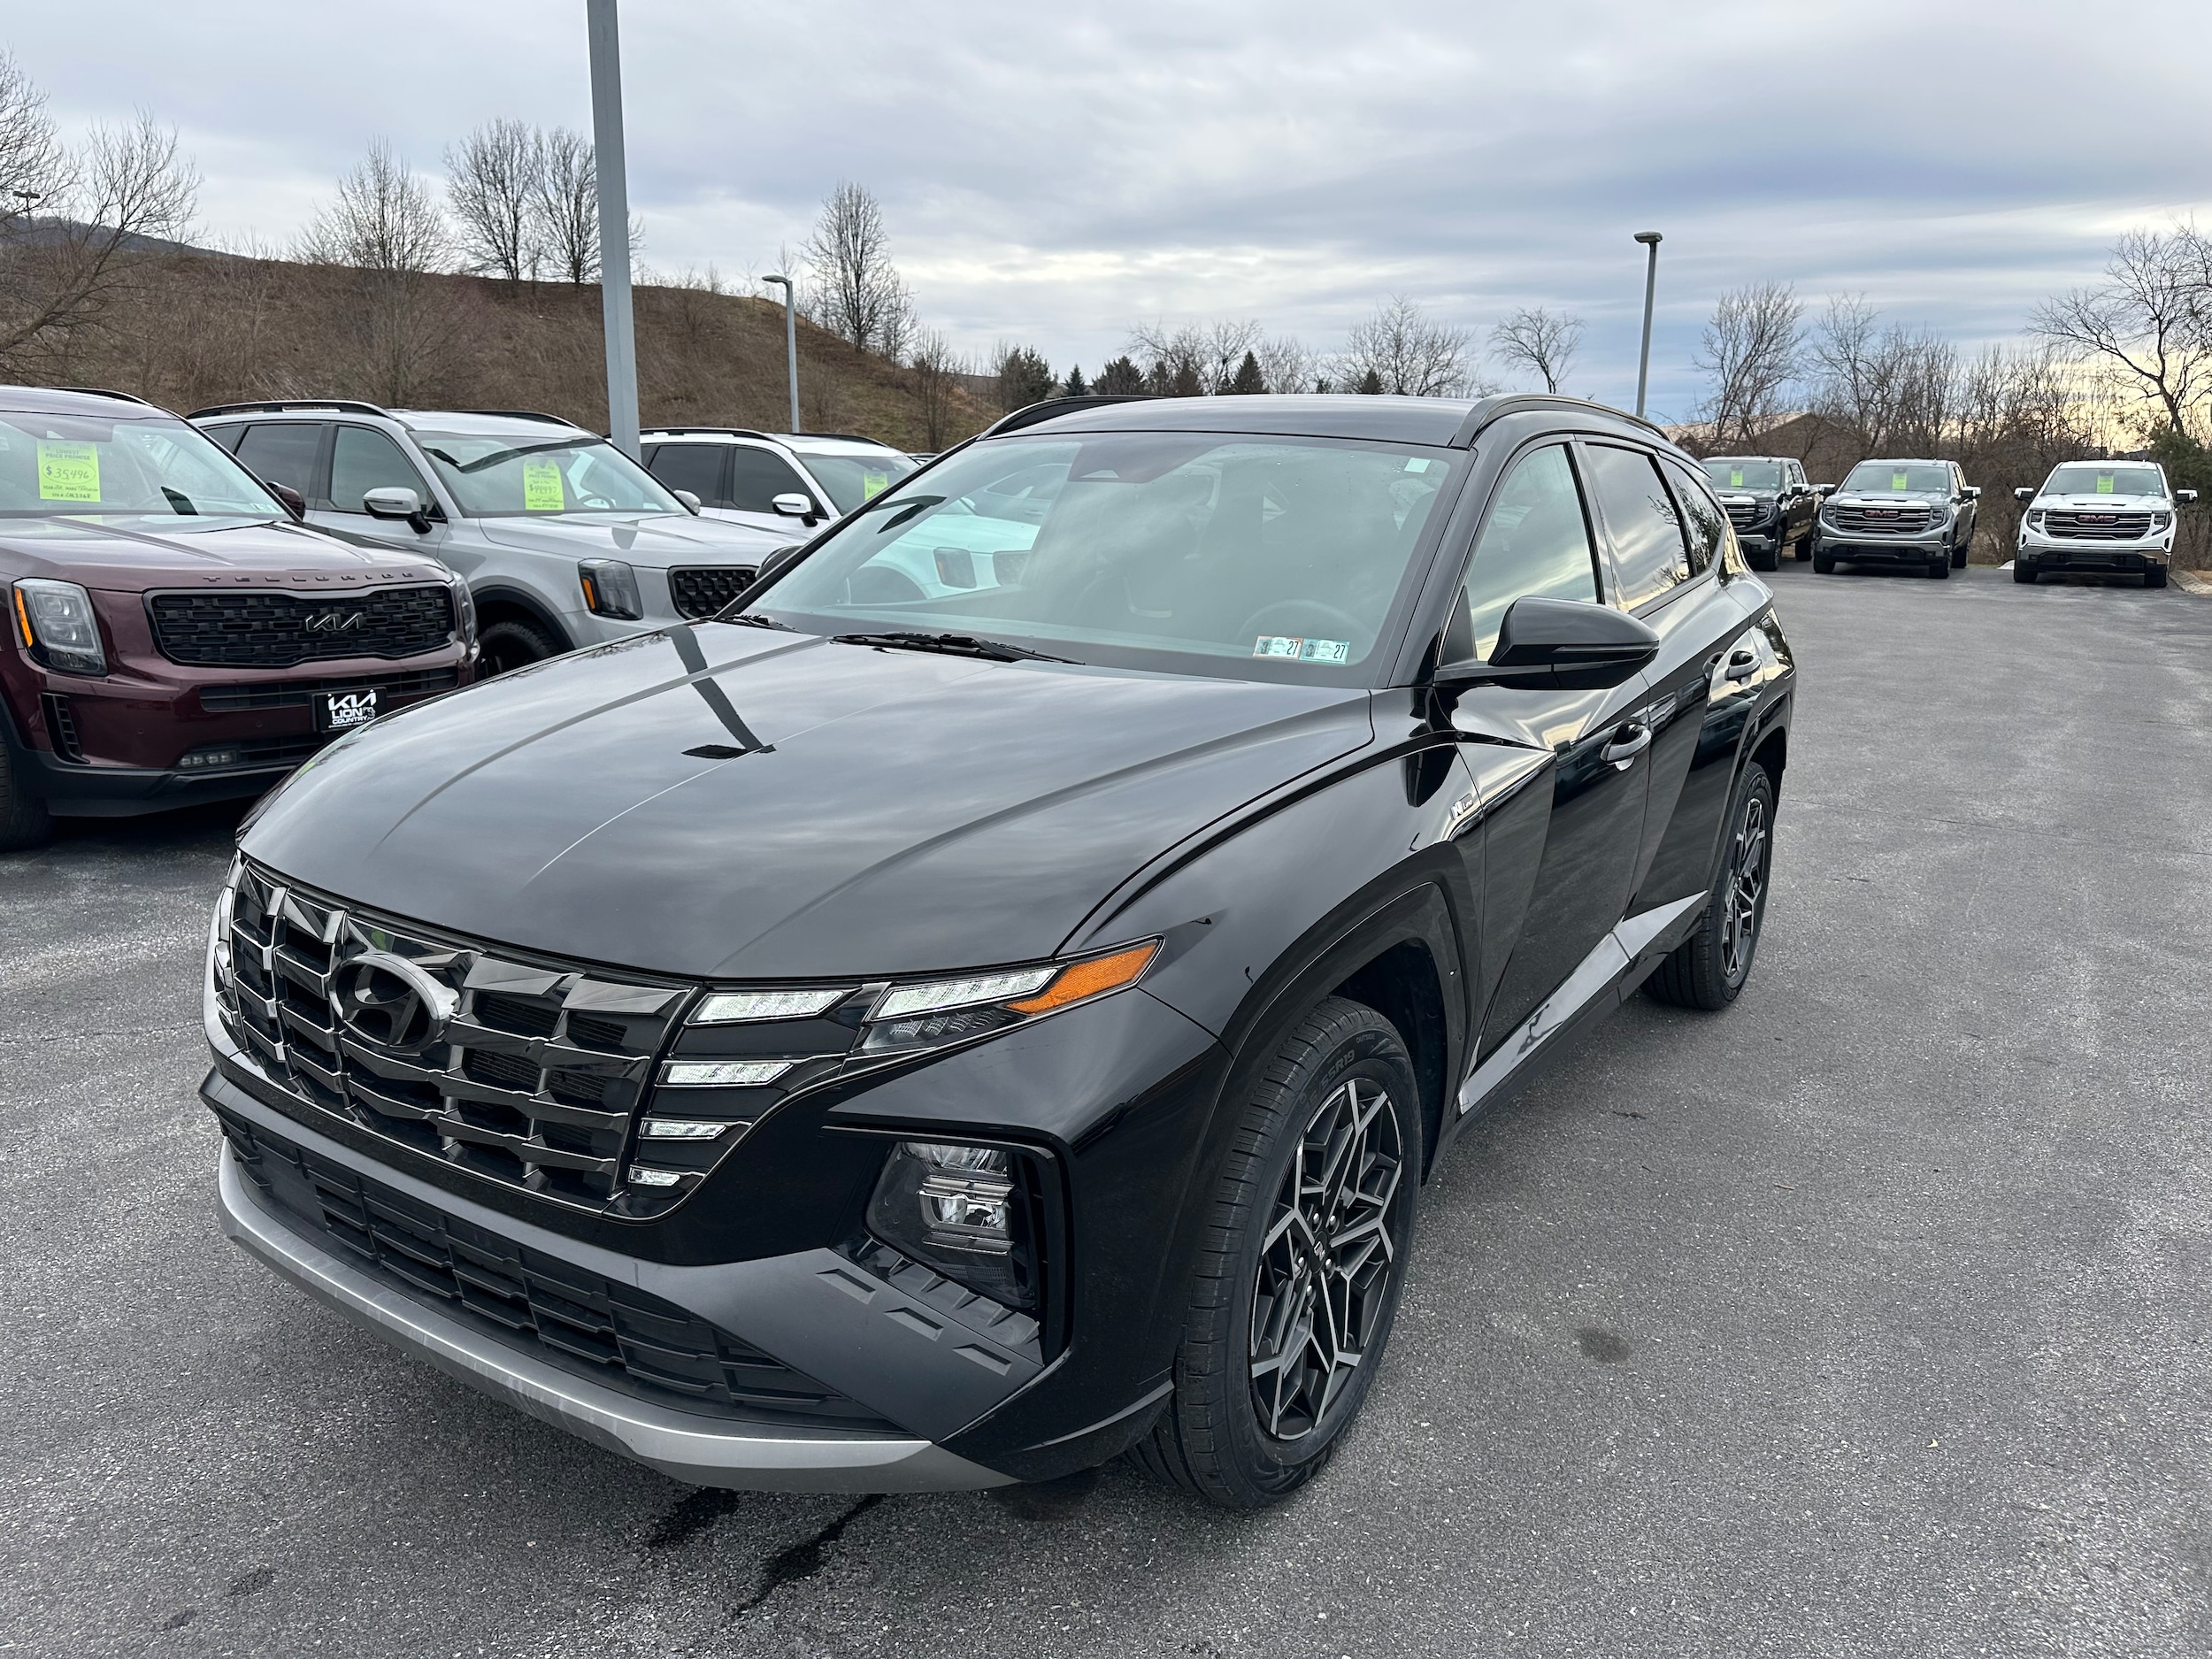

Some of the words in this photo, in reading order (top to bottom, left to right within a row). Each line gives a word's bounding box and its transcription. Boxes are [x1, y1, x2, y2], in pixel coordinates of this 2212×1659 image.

[1864, 509, 1899, 518] GMC
[203, 572, 413, 582] TELLURIDE
[1260, 641, 1269, 654] 3
[1286, 641, 1299, 656] 27
[1333, 644, 1346, 659] 27
[327, 692, 377, 711] KIA
[331, 708, 363, 719] LION
[332, 715, 368, 725] COUNTRY
[1356, 1033, 1376, 1044] OUTSIDE
